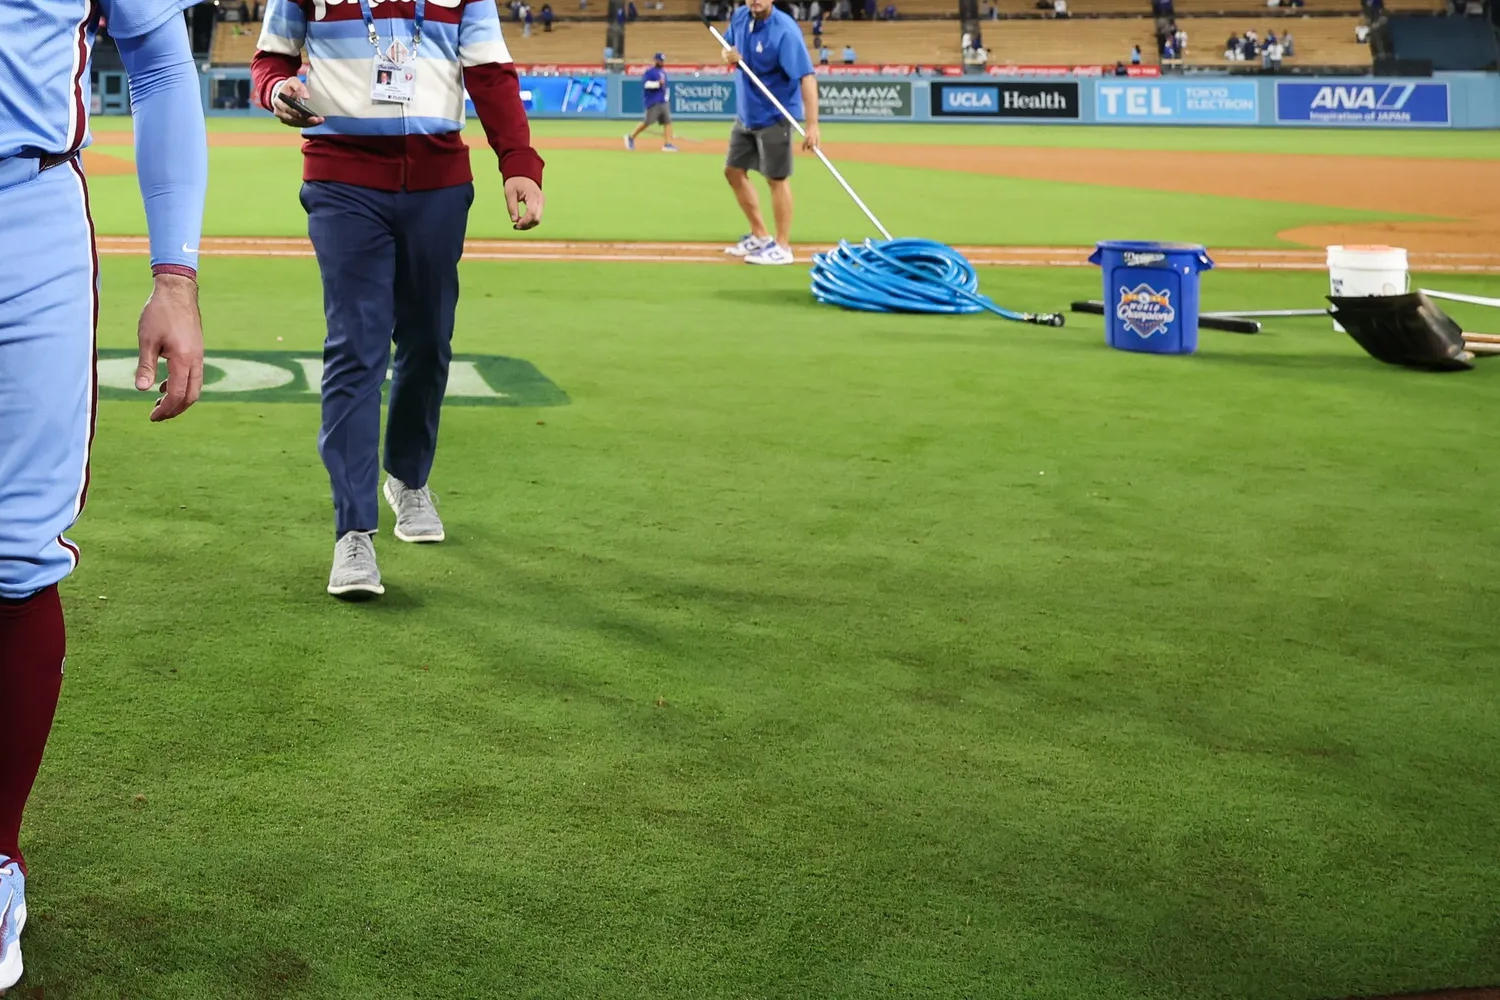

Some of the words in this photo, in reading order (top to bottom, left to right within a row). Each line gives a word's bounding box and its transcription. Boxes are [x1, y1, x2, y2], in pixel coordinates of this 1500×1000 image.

[675, 84, 731, 102] Security
[949, 91, 991, 107] UCLA
[1004, 90, 1066, 110] Health
[1186, 87, 1228, 98] TOKYO
[1311, 86, 1375, 109] ANA
[675, 99, 724, 112] Benefit
[1102, 87, 1172, 115] TEL
[1187, 99, 1253, 110] ELECTRON
[1310, 111, 1361, 122] Inspiration
[1364, 111, 1375, 120] of
[1377, 112, 1411, 122] JAPAN
[1118, 306, 1174, 322] Champions
